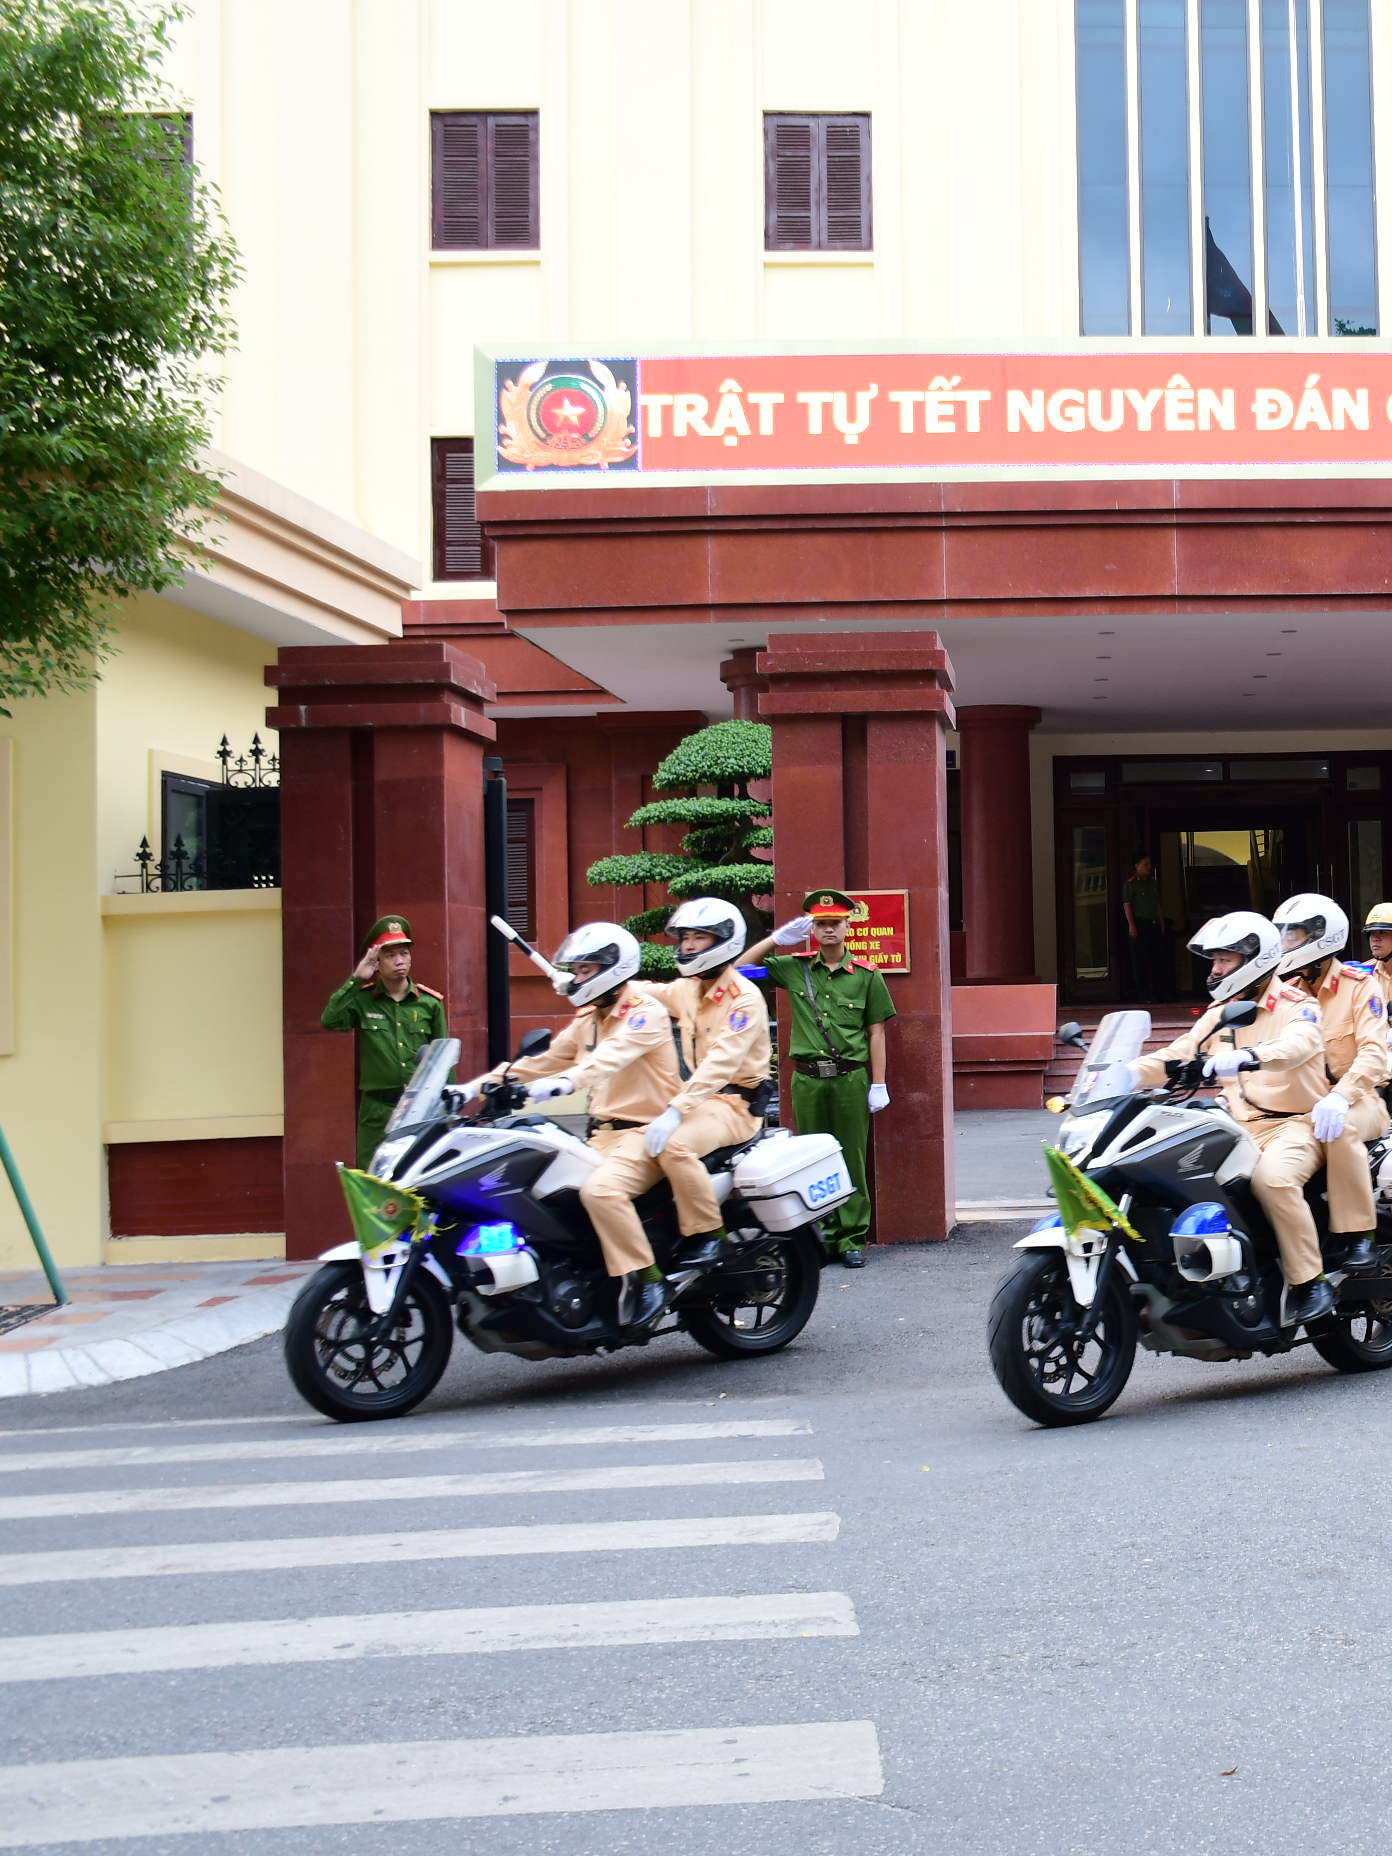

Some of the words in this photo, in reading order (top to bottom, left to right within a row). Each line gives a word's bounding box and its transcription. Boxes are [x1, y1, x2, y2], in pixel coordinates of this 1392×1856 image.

[641, 379, 784, 447] TRẬT
[797, 383, 878, 445] TỰ
[889, 376, 991, 434] TẾT
[1007, 373, 1236, 432] NGUYÊN
[1251, 374, 1370, 431] ĐÁN
[871, 927, 894, 937] QUAN
[1317, 929, 1345, 949] CSGT
[870, 941, 880, 950] XE
[808, 1172, 840, 1202] CSGT
